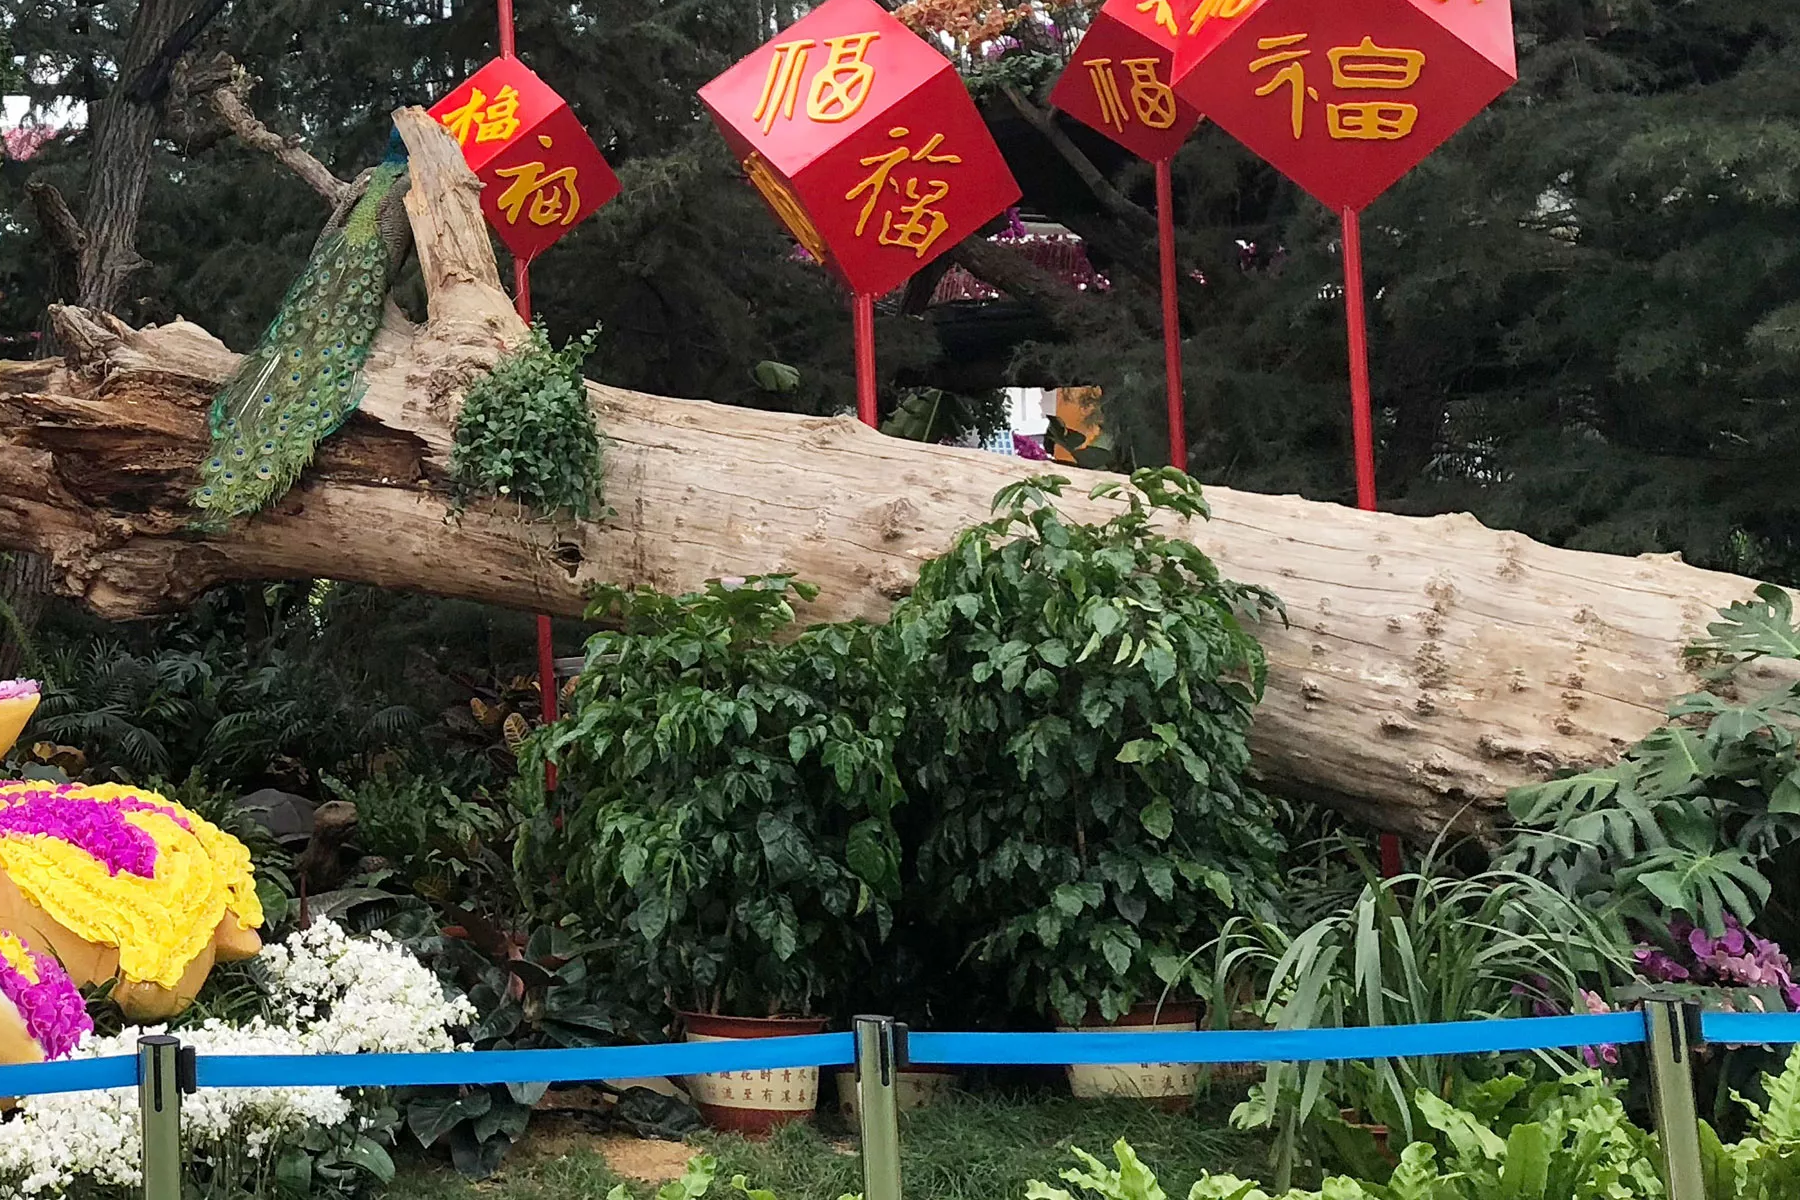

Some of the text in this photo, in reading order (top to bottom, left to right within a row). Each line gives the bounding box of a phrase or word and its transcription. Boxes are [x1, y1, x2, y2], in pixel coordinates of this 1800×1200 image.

[442, 84, 520, 147] 福
[752, 31, 881, 136] 福
[1083, 58, 1176, 133] 福
[1249, 33, 1426, 140] 福
[845, 127, 961, 258] 福
